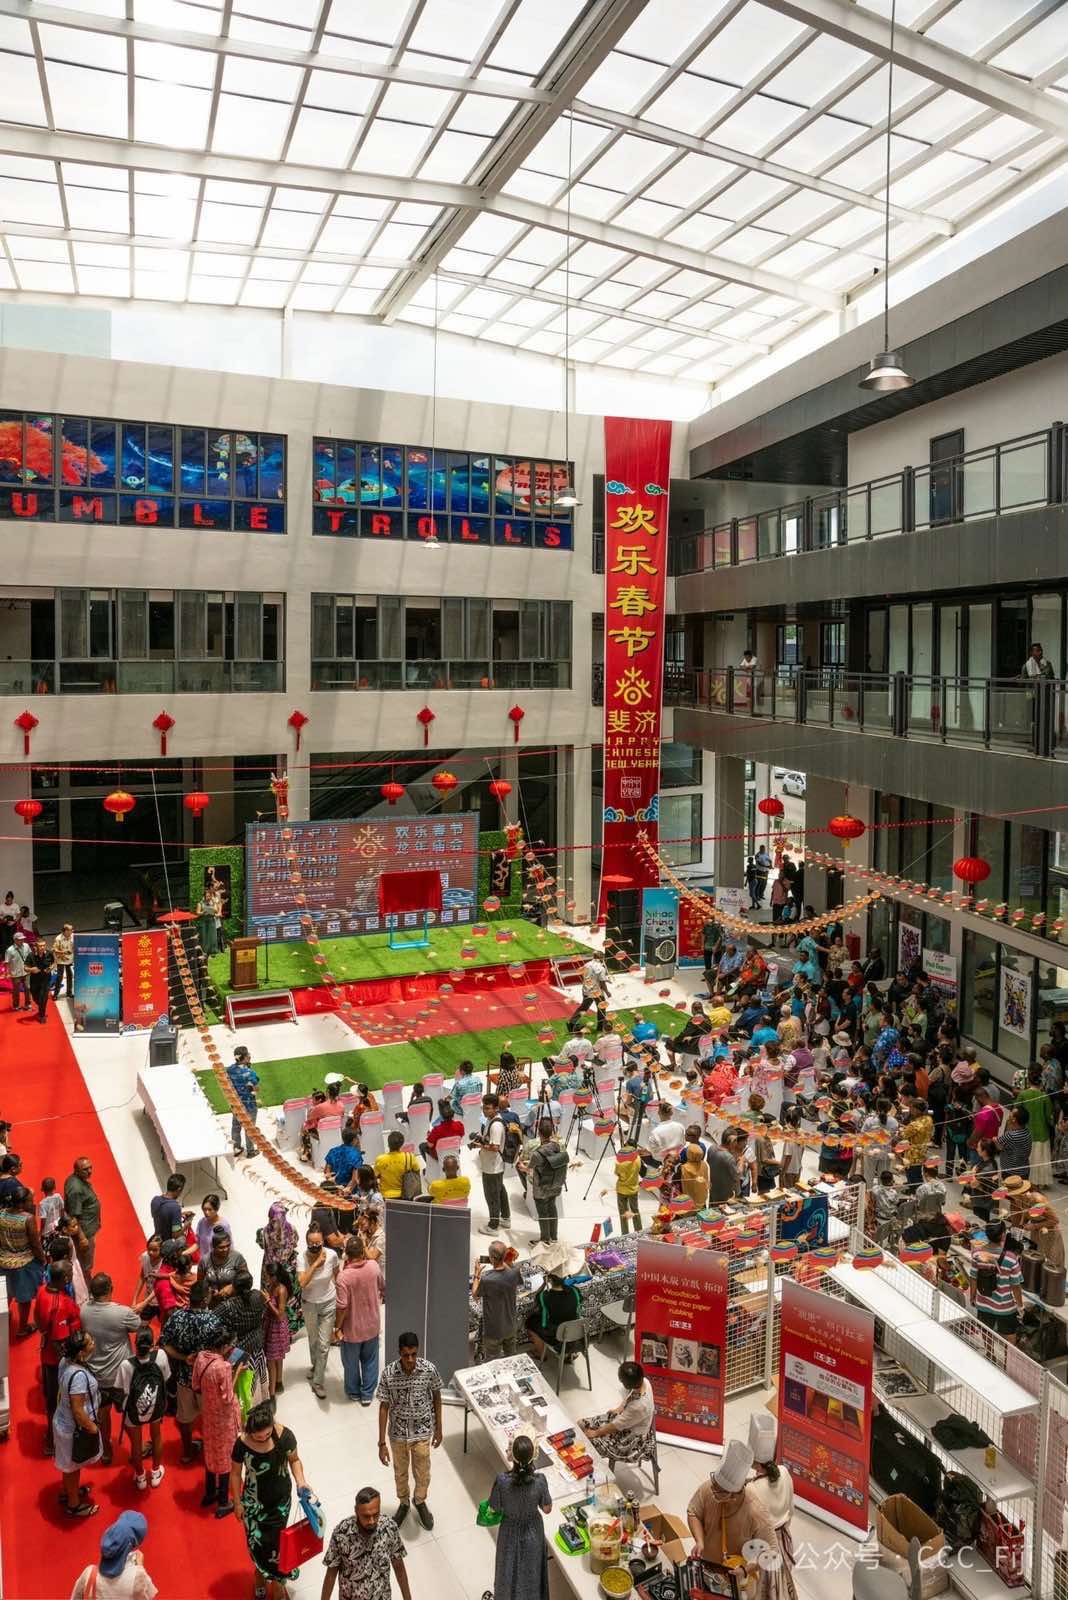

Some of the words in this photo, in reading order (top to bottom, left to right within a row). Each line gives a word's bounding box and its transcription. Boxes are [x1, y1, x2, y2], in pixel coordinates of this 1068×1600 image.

[325, 510, 562, 547] TROLLS
[608, 503, 659, 657] 欢乐春节
[608, 709, 657, 734] 斐济
[137, 958, 153, 1001] 欢乐春节
[651, 1295, 678, 1306] Chinese
[692, 1303, 712, 1313] paper
